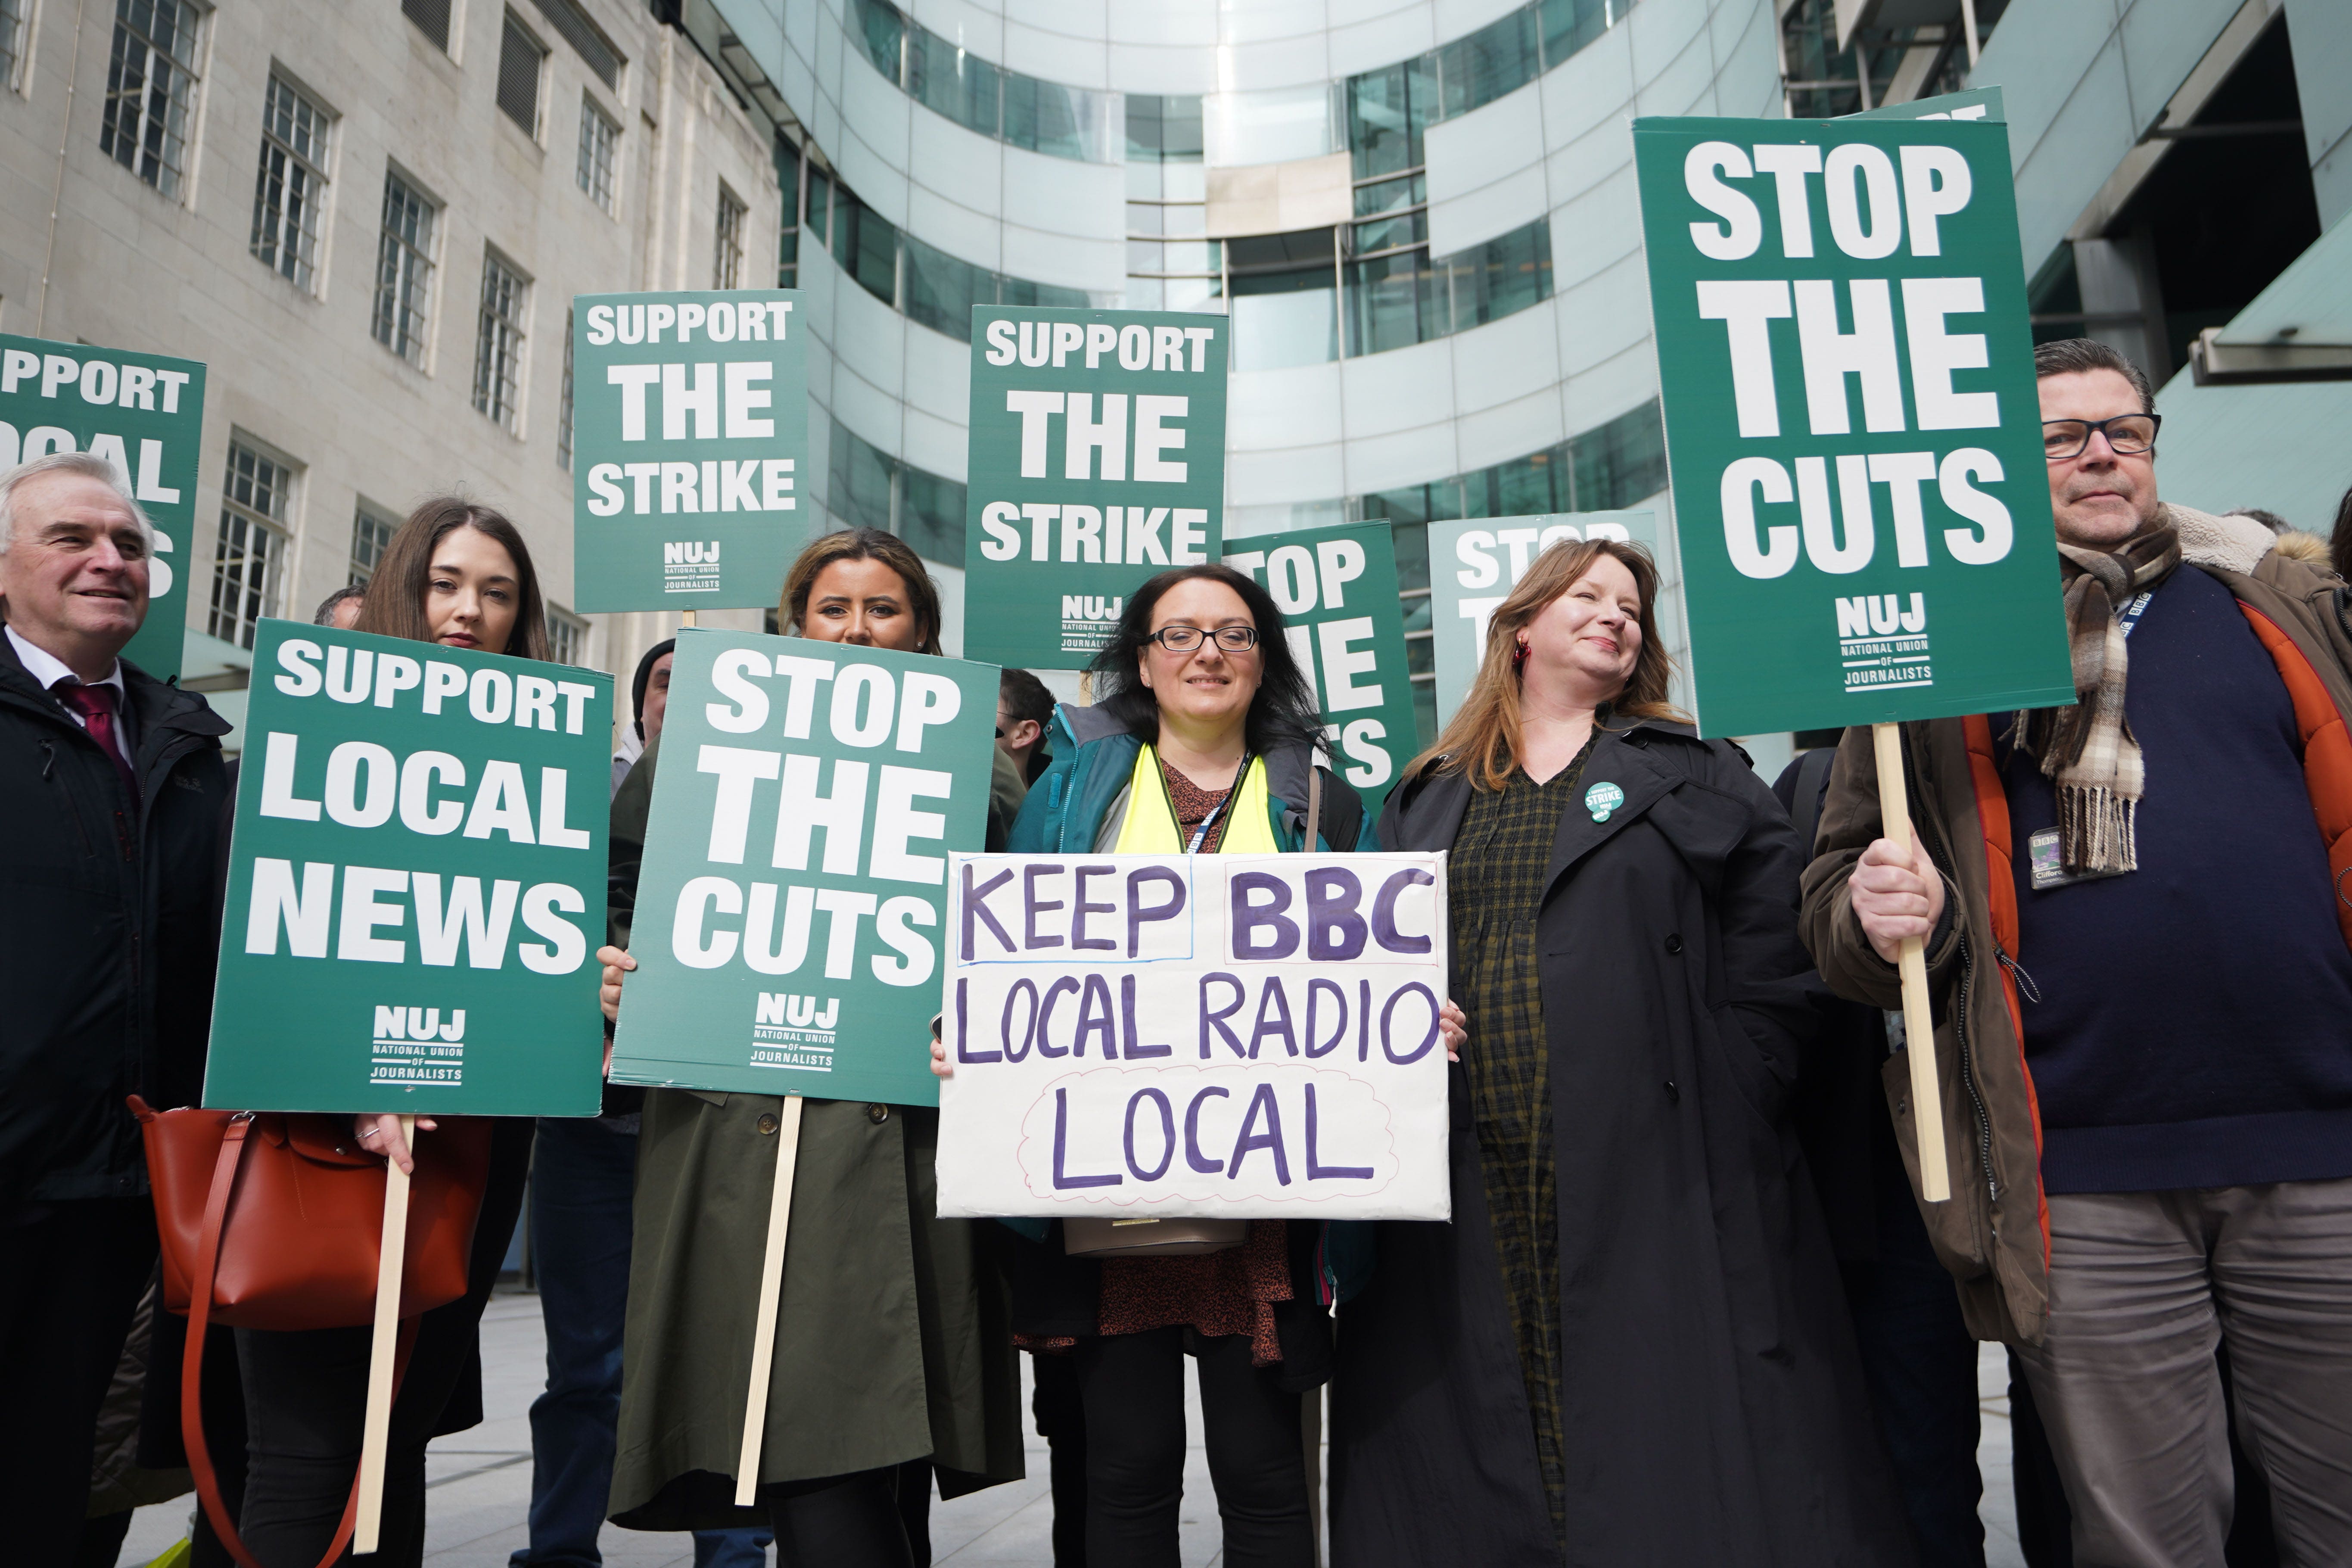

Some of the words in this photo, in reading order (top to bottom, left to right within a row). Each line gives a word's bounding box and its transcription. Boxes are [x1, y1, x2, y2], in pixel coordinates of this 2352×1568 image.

[1685, 141, 1971, 260] STOP
[587, 302, 792, 345] SUPPORT
[986, 320, 1213, 372] SUPPORT
[1696, 277, 2000, 437] THE
[608, 362, 774, 441] THE
[1007, 390, 1188, 482] THE
[588, 459, 795, 516] STRIKE
[1721, 448, 2013, 579] CUTS
[665, 541, 719, 563] NUJ
[980, 501, 1207, 566] STRIKE
[1456, 523, 1630, 588] ST
[1062, 595, 1122, 620] NUJ
[1836, 593, 1925, 637] NUJ
[2131, 592, 2149, 614] BBC
[1061, 639, 1113, 647] JOURNALIS
[1841, 644, 1892, 656] NATIONAL
[1896, 640, 1928, 651] UNION
[1881, 656, 1892, 666] OF
[274, 639, 595, 735] SUPPORT
[706, 649, 961, 753] STOP
[1845, 666, 1932, 685] JOURNALISTS
[260, 732, 590, 849] LOCAL
[697, 744, 953, 885] THE
[1586, 790, 1621, 806] STRIKE
[2034, 836, 2057, 846] BBC
[246, 857, 586, 974] NEWS
[672, 877, 936, 986] CUTS
[961, 864, 1186, 961] KEEP
[1231, 867, 1434, 961] BBC
[373, 1005, 465, 1041] NUJ
[754, 1030, 801, 1041] NATIONAL
[806, 1034, 834, 1043] UNION
[756, 992, 839, 1029] NUJ
[956, 974, 1172, 1064] LOCAL
[1199, 972, 1440, 1065] RADIO
[370, 1067, 461, 1079] JOURNALISTS
[373, 1045, 426, 1055] NATIONAL
[431, 1048, 463, 1056] UNION
[751, 1051, 832, 1065] JOURNALISTS
[1053, 1083, 1374, 1190] LOCAL
